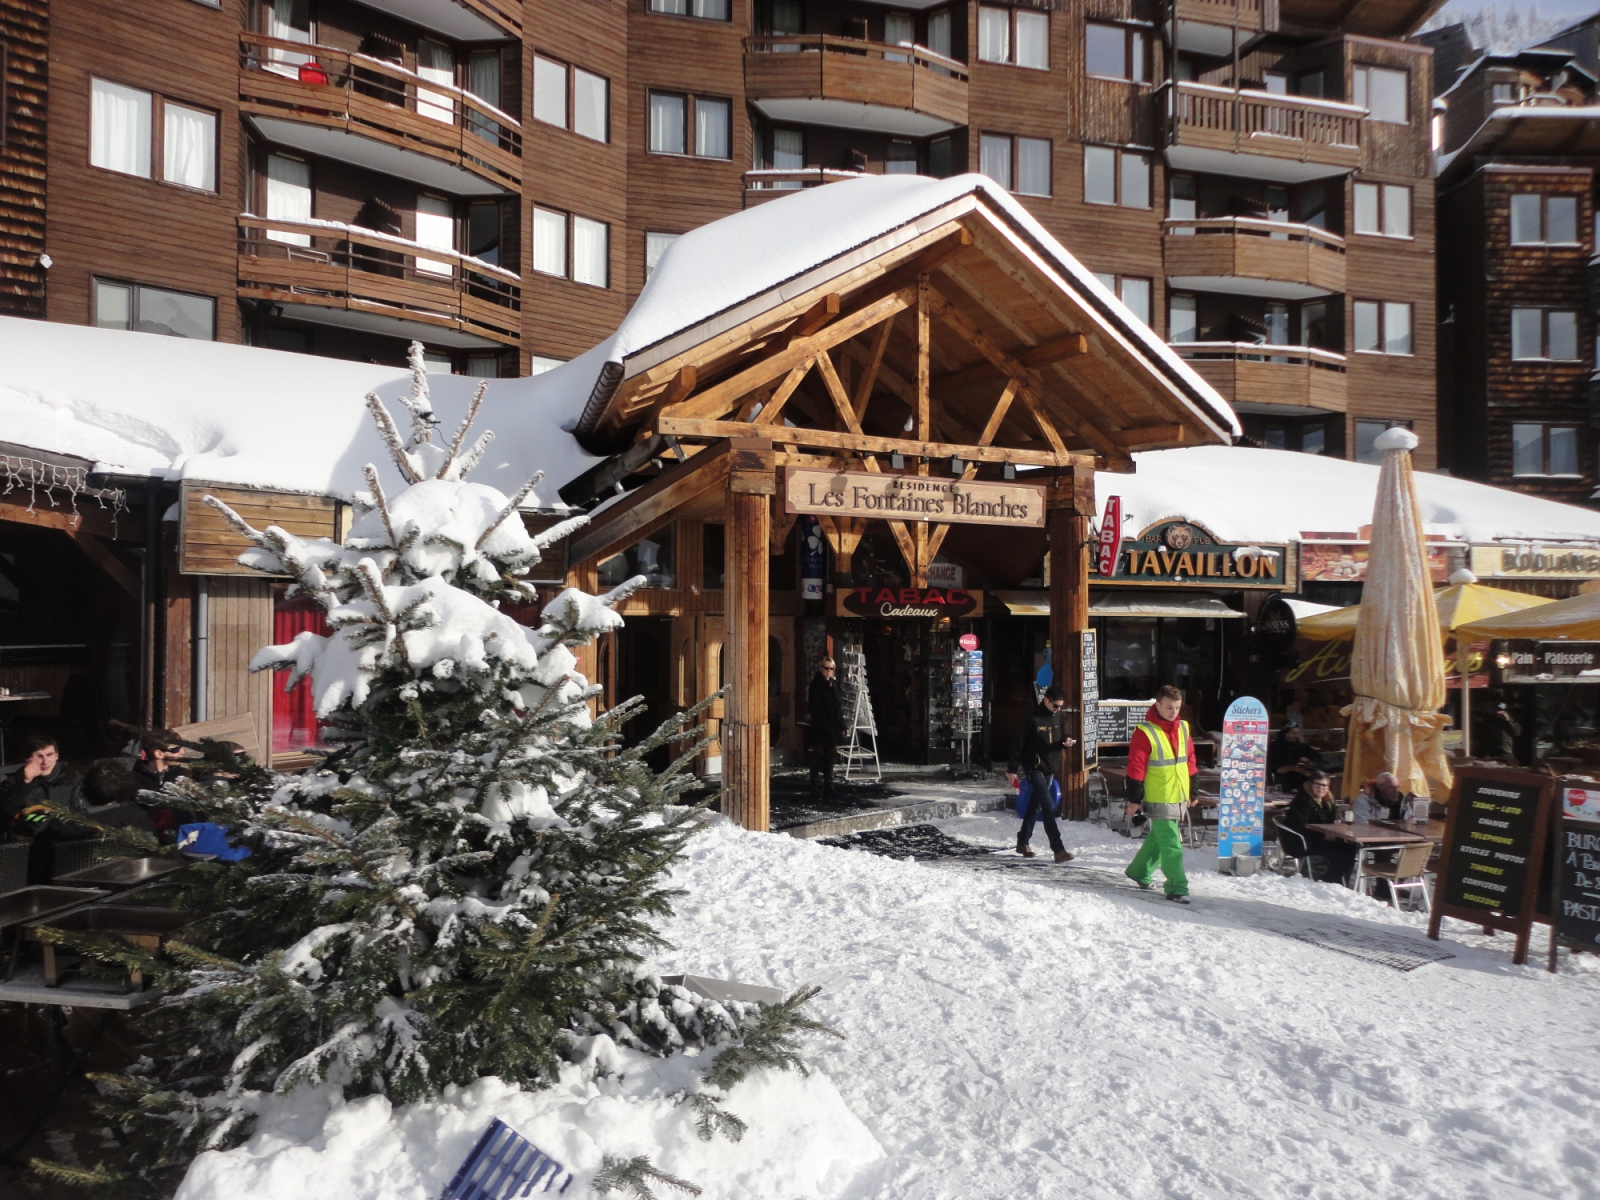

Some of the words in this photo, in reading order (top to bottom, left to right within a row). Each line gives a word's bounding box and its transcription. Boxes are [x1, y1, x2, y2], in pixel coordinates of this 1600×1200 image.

[893, 480, 954, 494] RESIDENCE
[808, 482, 844, 508] Les
[852, 486, 945, 514] Fontaines
[952, 492, 1028, 519] Blanches
[1099, 499, 1116, 574] TABAC
[1145, 534, 1162, 544] BAR
[1193, 536, 1211, 546] PUB
[1126, 549, 1277, 578] TAVAILLON
[852, 587, 969, 605] TABAC
[880, 602, 938, 617] Cadeaux
[1511, 651, 1534, 665] Pain
[1231, 704, 1262, 715] Stickers
[1477, 787, 1521, 799] SOUVENIRS
[1501, 805, 1522, 815] LOTO
[1478, 817, 1510, 829] CHANGE
[1494, 852, 1526, 864] PHOTOS
[1462, 876, 1508, 893] CONFISERIE
